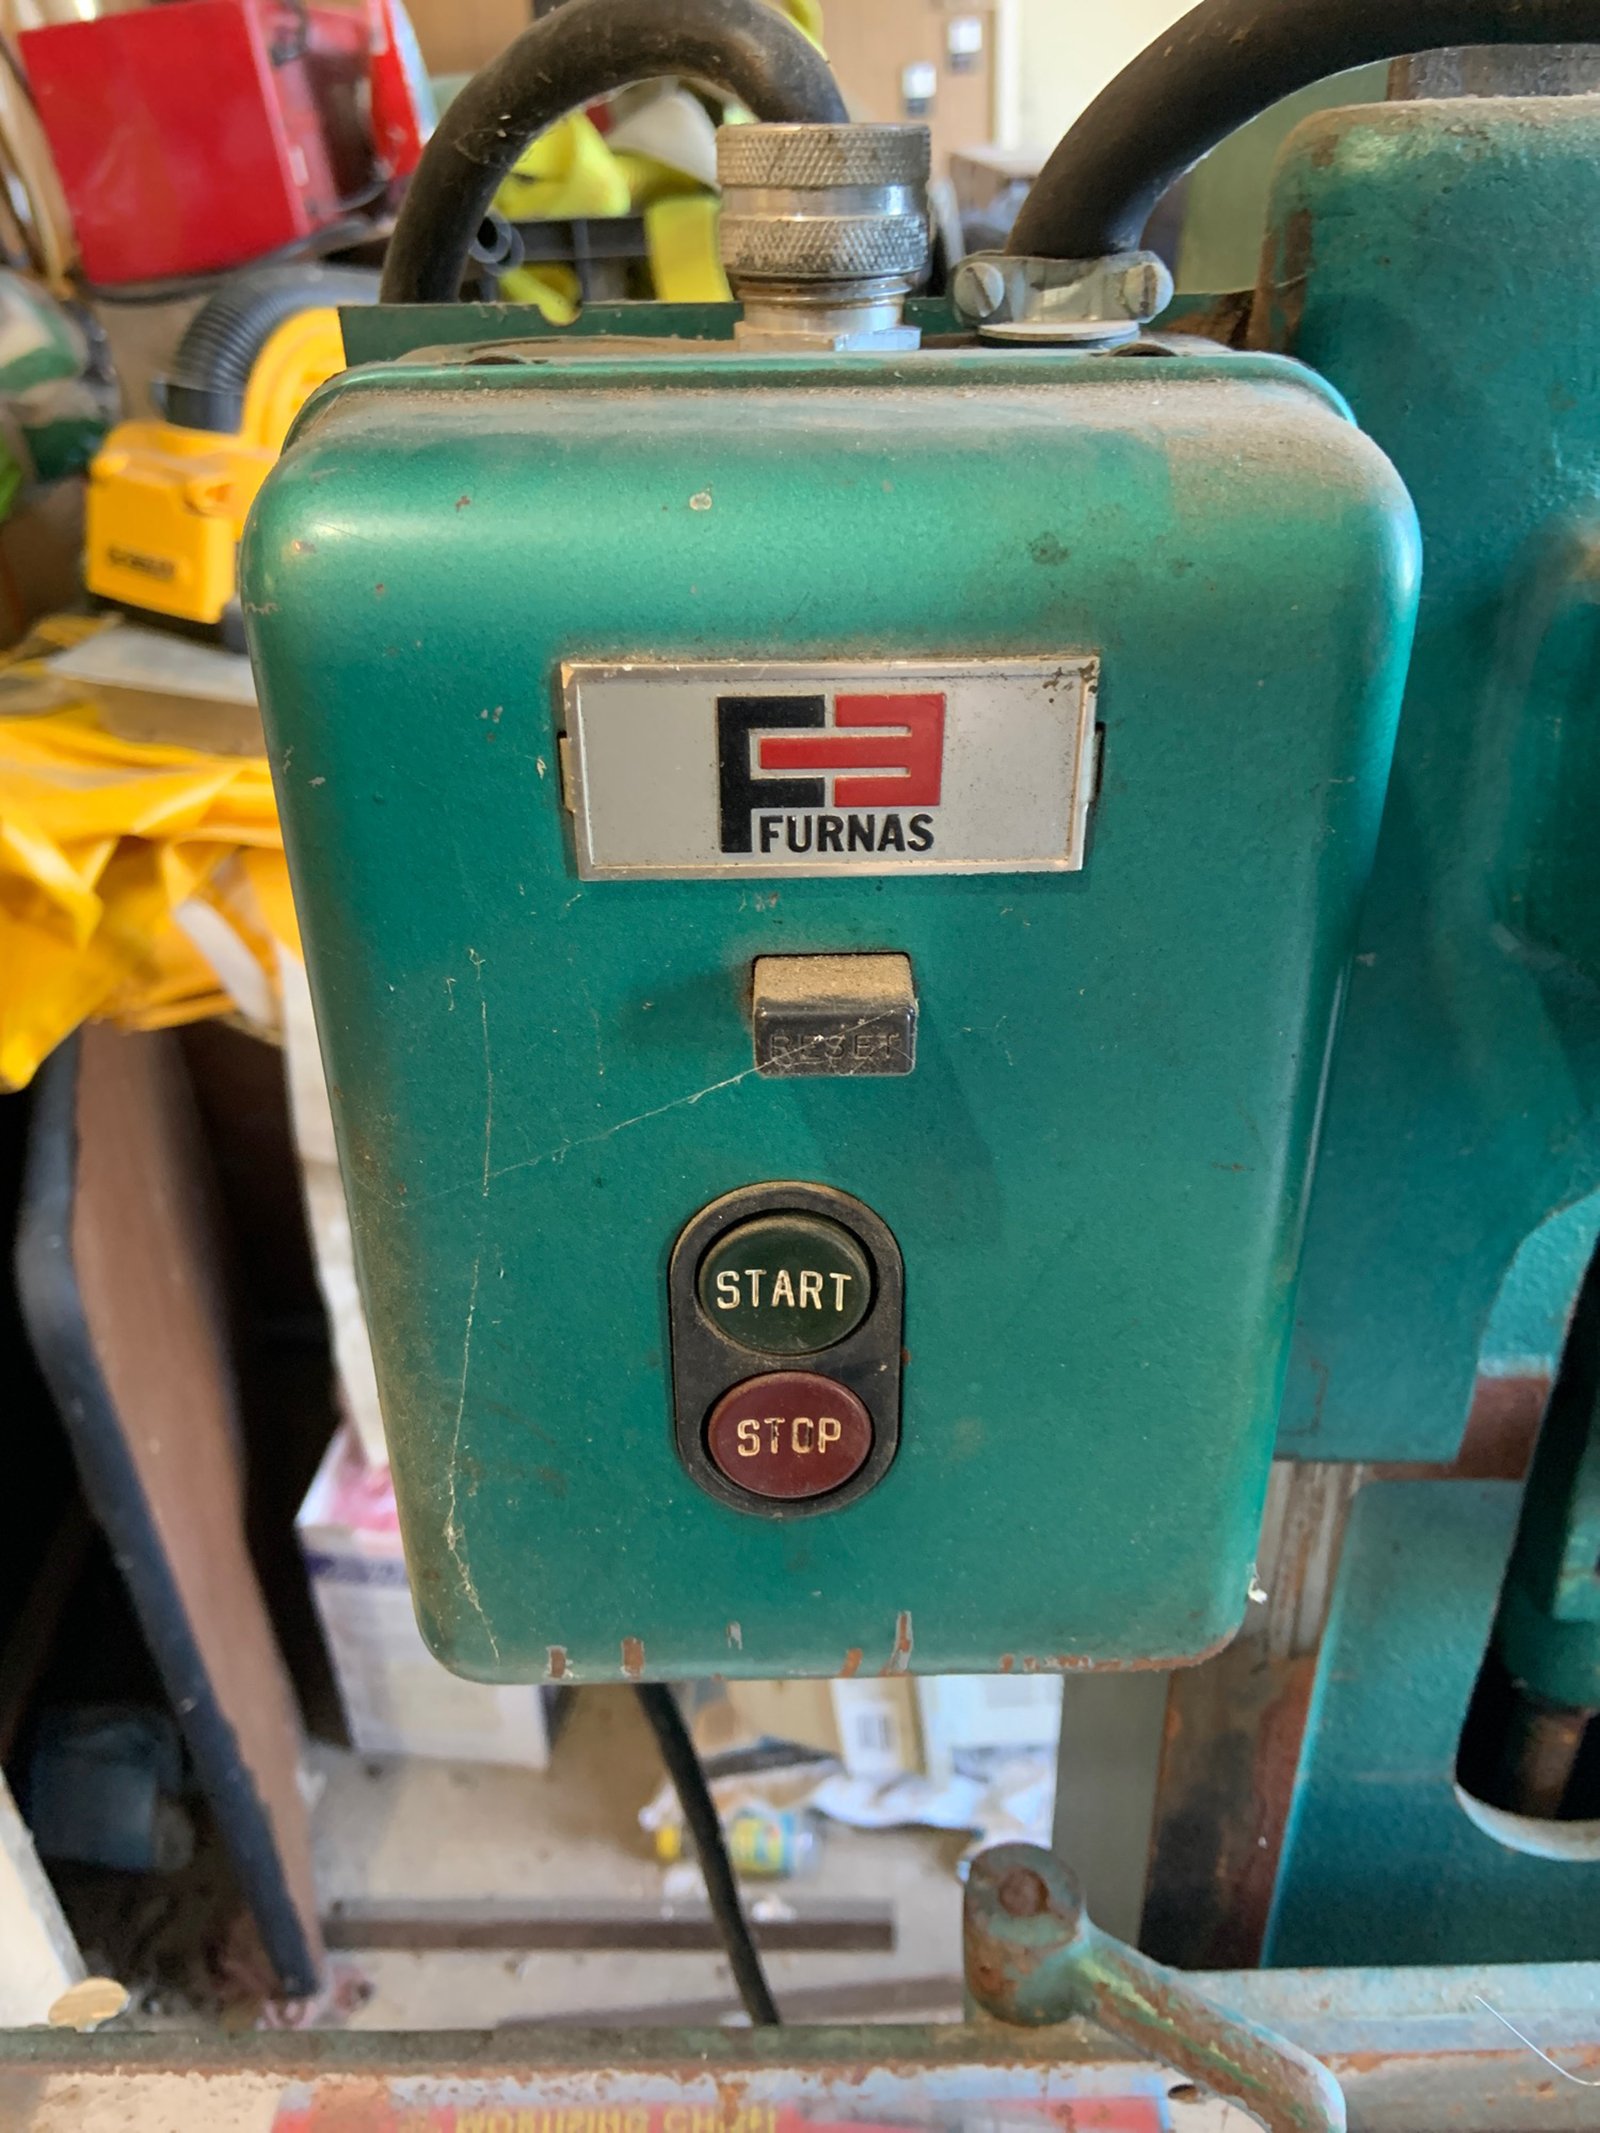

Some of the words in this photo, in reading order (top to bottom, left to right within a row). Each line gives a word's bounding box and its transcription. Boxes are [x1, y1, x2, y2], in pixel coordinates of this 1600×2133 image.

[759, 813, 935, 853] FURNAS
[768, 1032, 901, 1061] RESET
[716, 1269, 852, 1312] START
[736, 1417, 842, 1457] STOP
